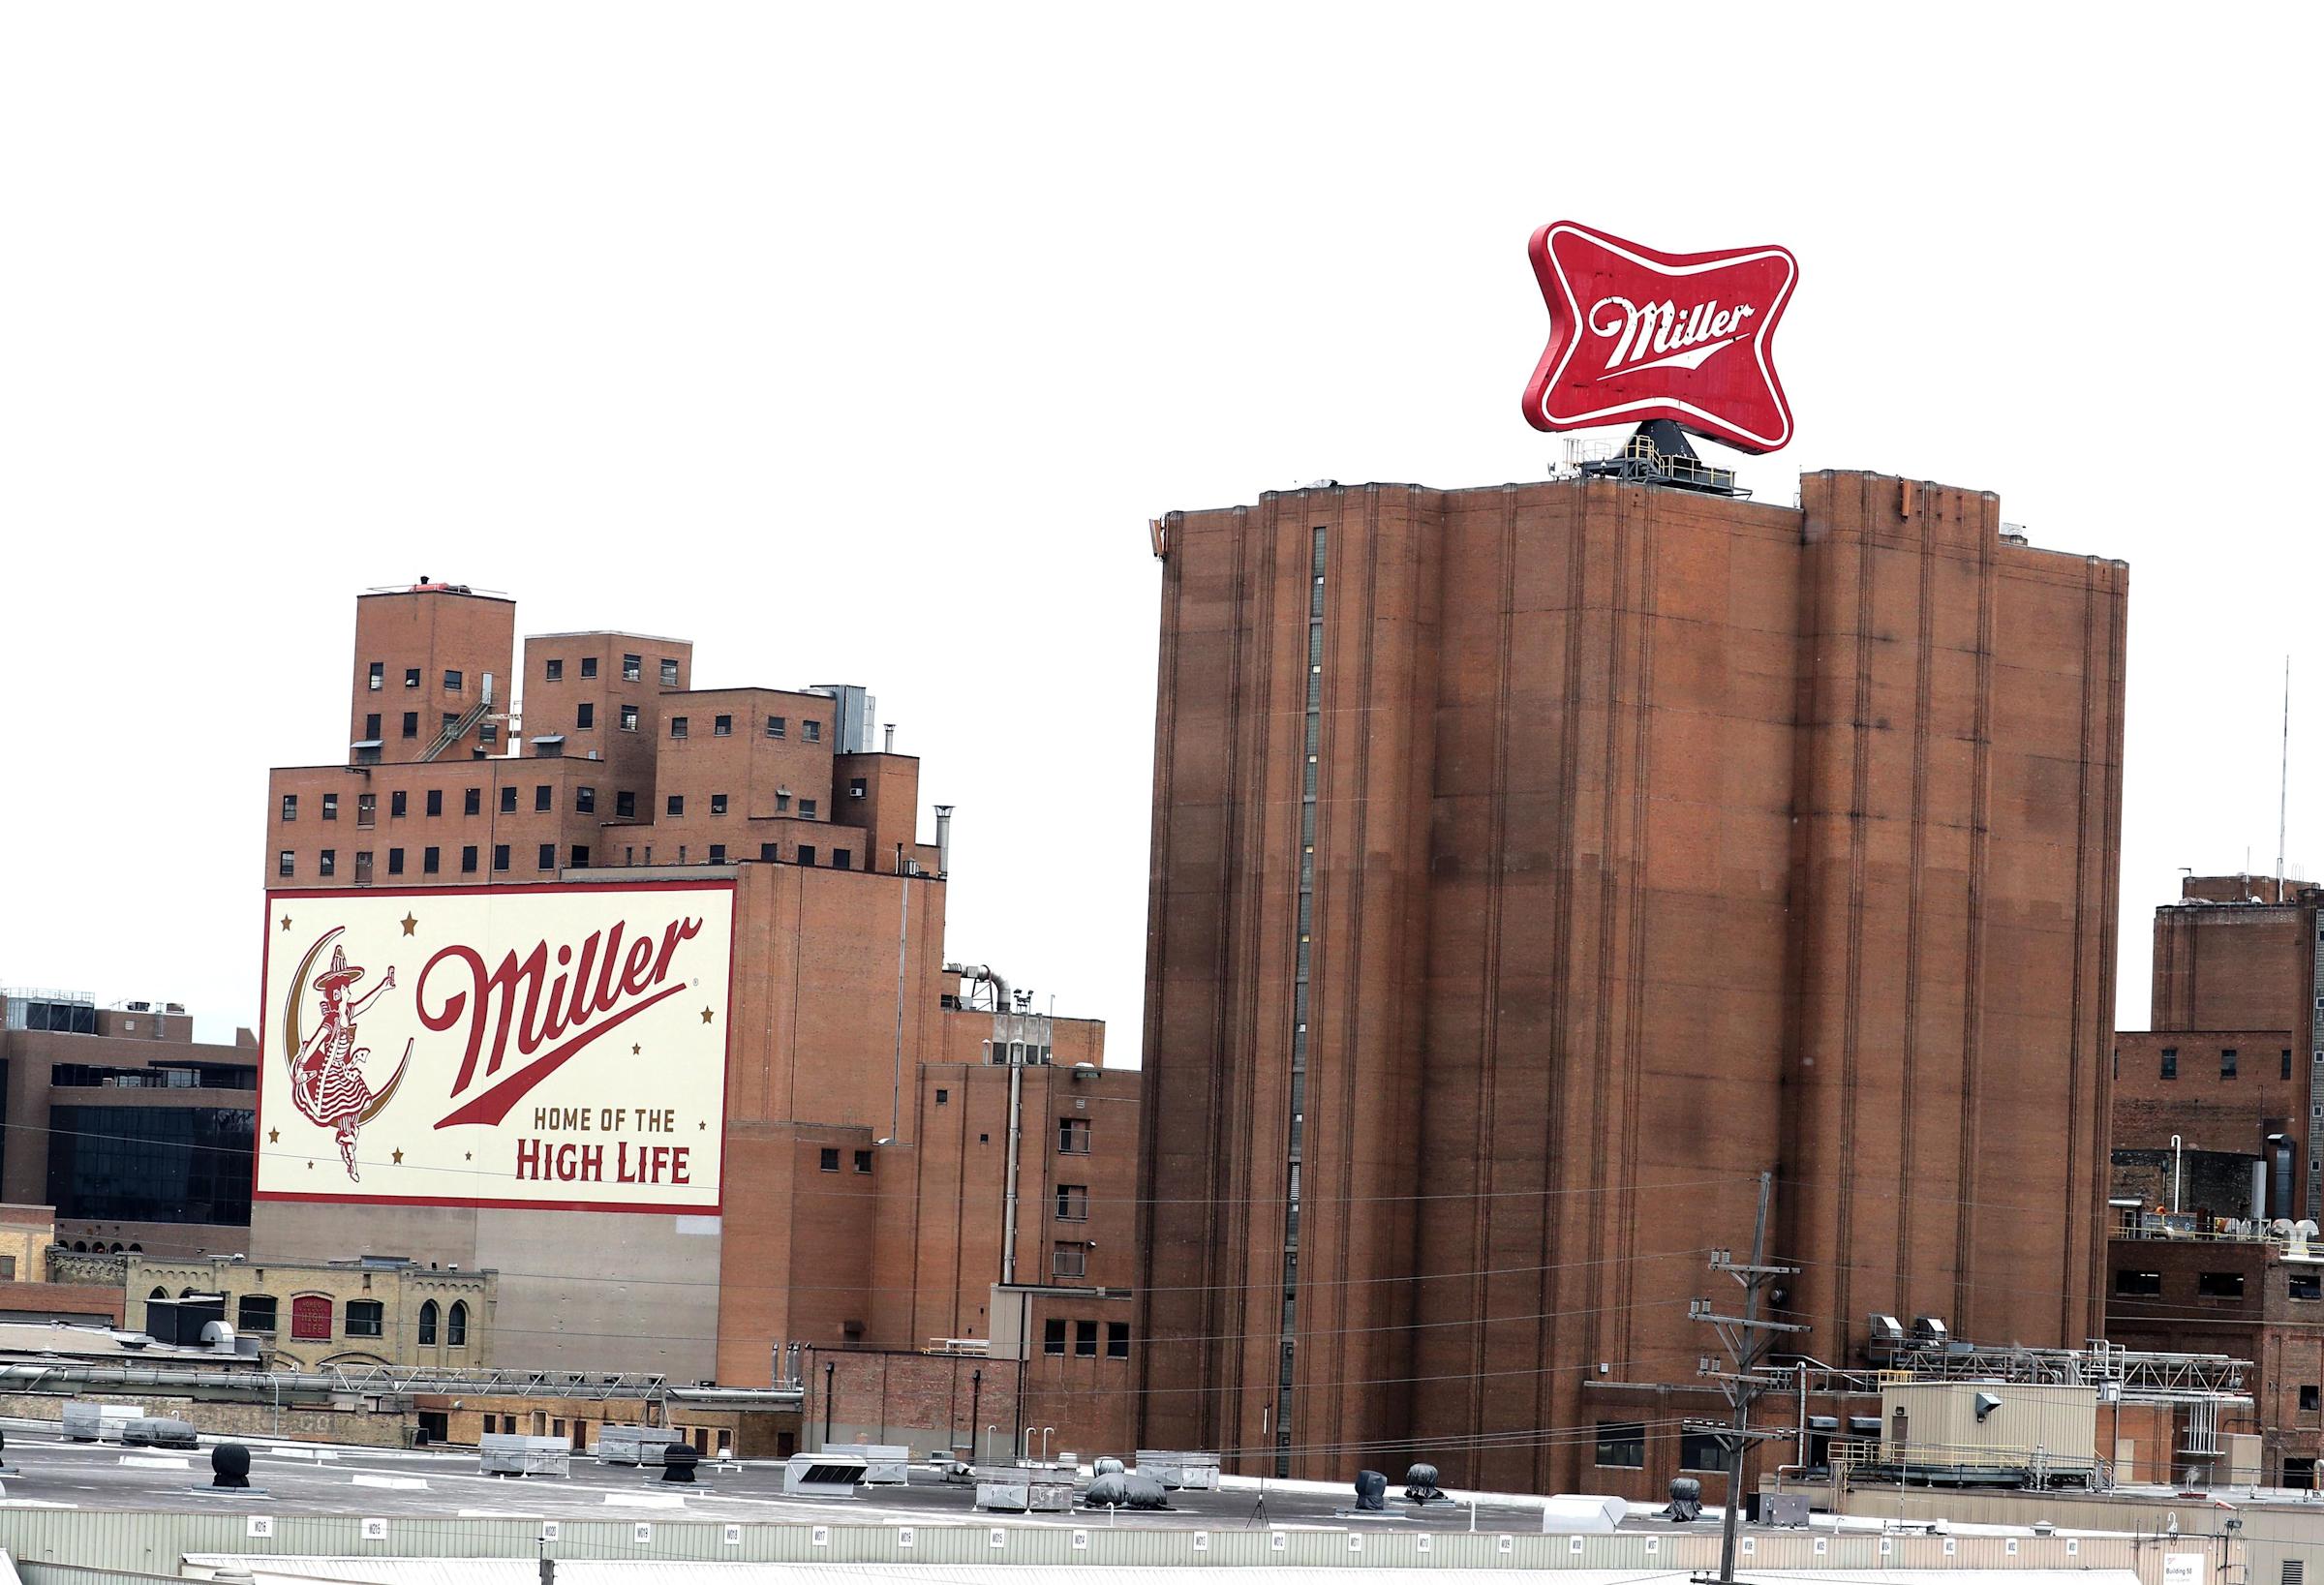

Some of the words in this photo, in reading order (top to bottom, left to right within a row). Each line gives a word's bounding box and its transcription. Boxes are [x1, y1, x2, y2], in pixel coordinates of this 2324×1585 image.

[1588, 296, 1756, 369] Miller
[416, 917, 703, 1099] Miller
[535, 1108, 591, 1131] HOME
[600, 1109, 626, 1131] OF
[635, 1110, 675, 1132] THE
[516, 1139, 604, 1181] HIGH
[617, 1142, 690, 1184] LIFE
[302, 1312, 324, 1322] HIGH
[301, 1324, 323, 1333] LIFE
[814, 1531, 825, 1540] W017
[1075, 1535, 1085, 1544] W014
